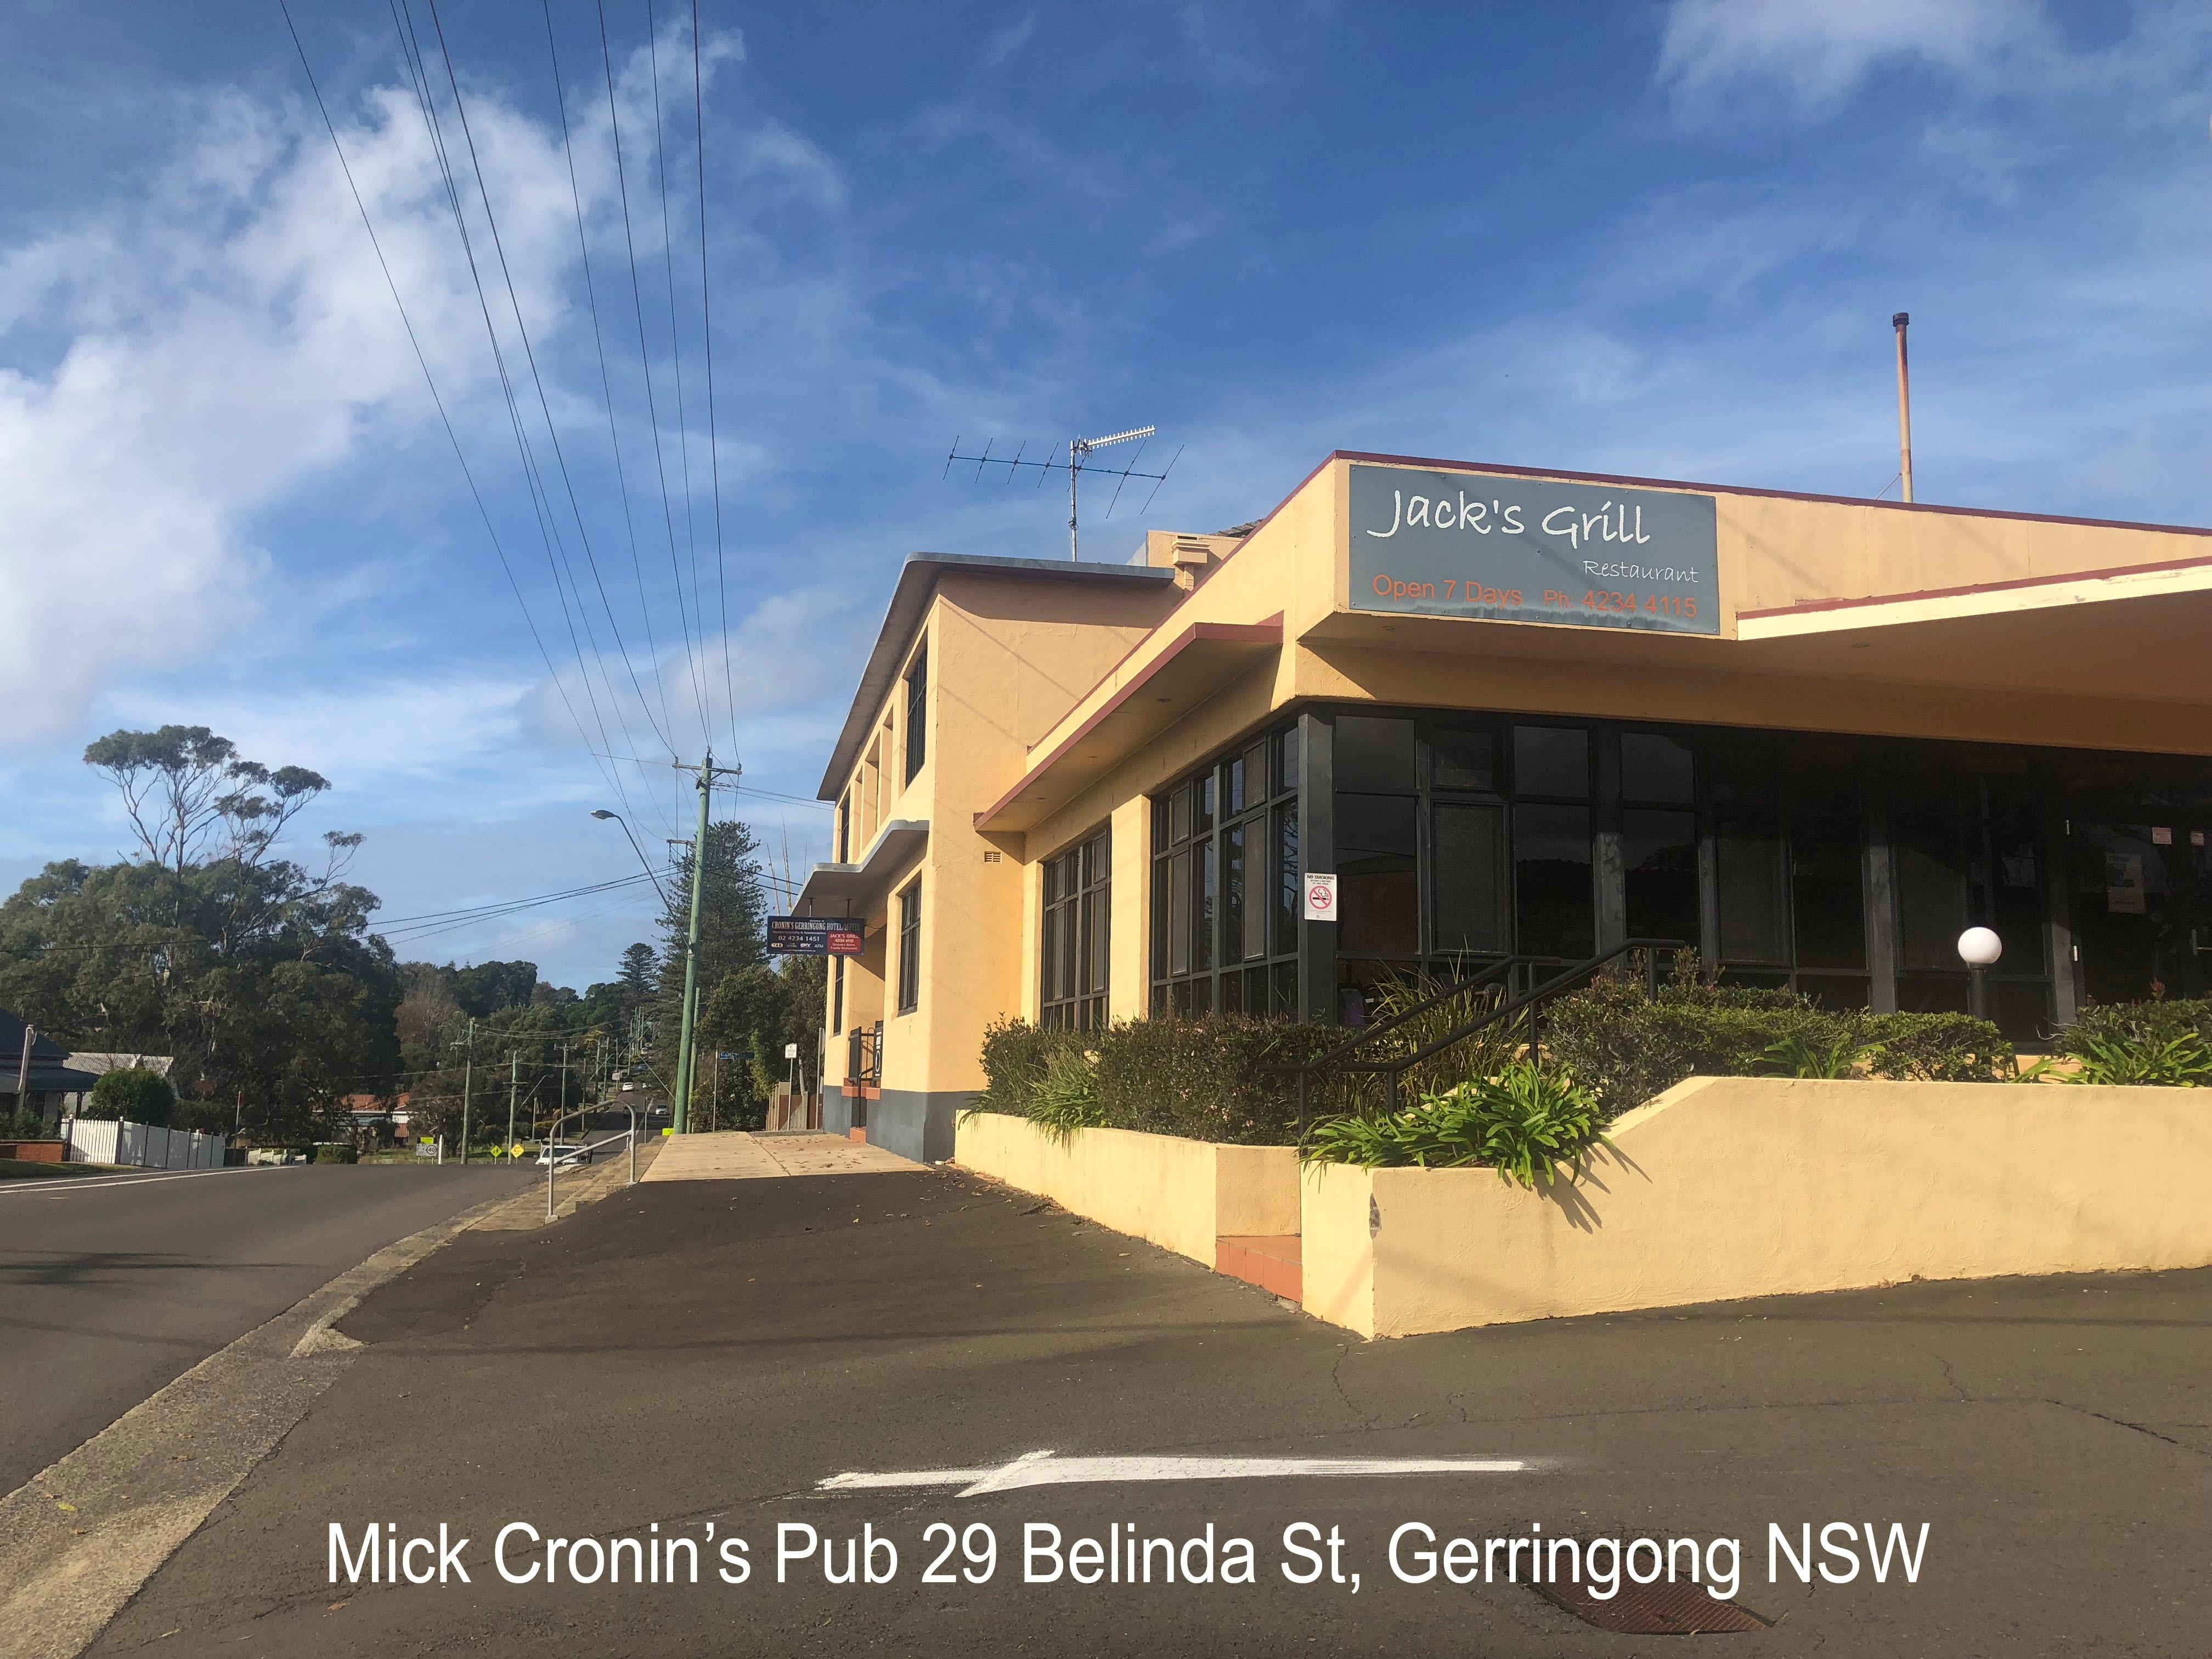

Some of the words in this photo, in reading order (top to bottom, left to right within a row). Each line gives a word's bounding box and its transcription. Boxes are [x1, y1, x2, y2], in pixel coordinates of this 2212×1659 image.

[1367, 490, 1525, 538] Jack's
[1542, 501, 1651, 549] Grill
[1583, 560, 1700, 583] Restaurant
[1373, 574, 1435, 602] Open
[1443, 579, 1457, 601] 7
[1465, 580, 1523, 609] Days
[1543, 589, 1574, 608] Ph:
[1582, 589, 1637, 614] 4234
[1644, 594, 1697, 618] 4115
[771, 921, 794, 929] CRONIN'S
[794, 922, 826, 930] GERRINGONG
[826, 922, 844, 931] HOTEL
[844, 923, 860, 931] MOTEL
